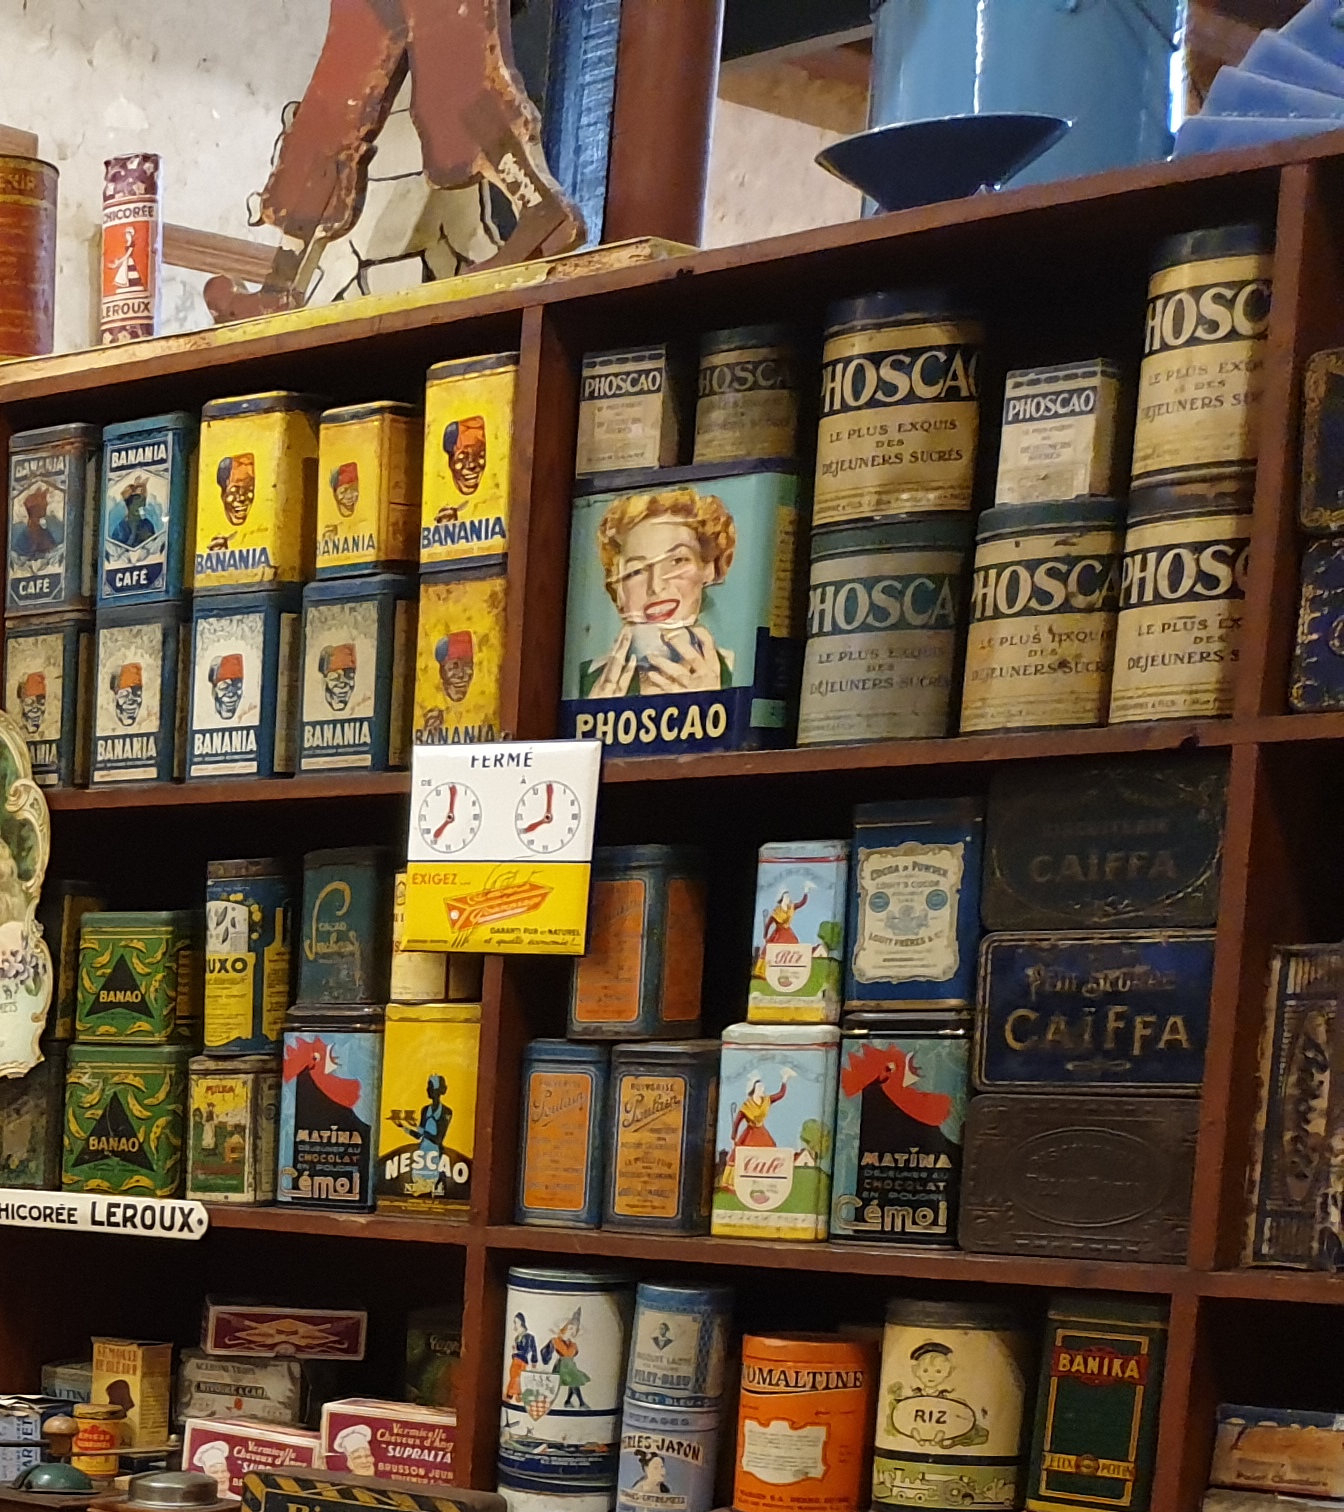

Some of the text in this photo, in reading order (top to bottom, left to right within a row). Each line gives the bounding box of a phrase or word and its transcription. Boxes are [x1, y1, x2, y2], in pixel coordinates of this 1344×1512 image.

[583, 369, 663, 399] PHOSCAO
[821, 350, 980, 414] HOSCA
[1007, 388, 1096, 420] PHOSCAO
[111, 443, 168, 467] BANANIA
[420, 516, 507, 550] BANANIA
[194, 546, 270, 575] BANANIA
[115, 568, 149, 589] CAFÉ
[810, 573, 955, 636] HOSCA
[303, 720, 372, 748] BANANIA
[574, 702, 727, 747] PHOSCAO
[96, 736, 158, 762] BANANIA
[193, 729, 258, 755] BANANIA
[98, 988, 142, 1005] BANAO
[88, 1133, 140, 1153] BANAO
[384, 1148, 469, 1186] NESCAO
[89, 1198, 195, 1233] LEROUX
[913, 1406, 948, 1425] RIZ
